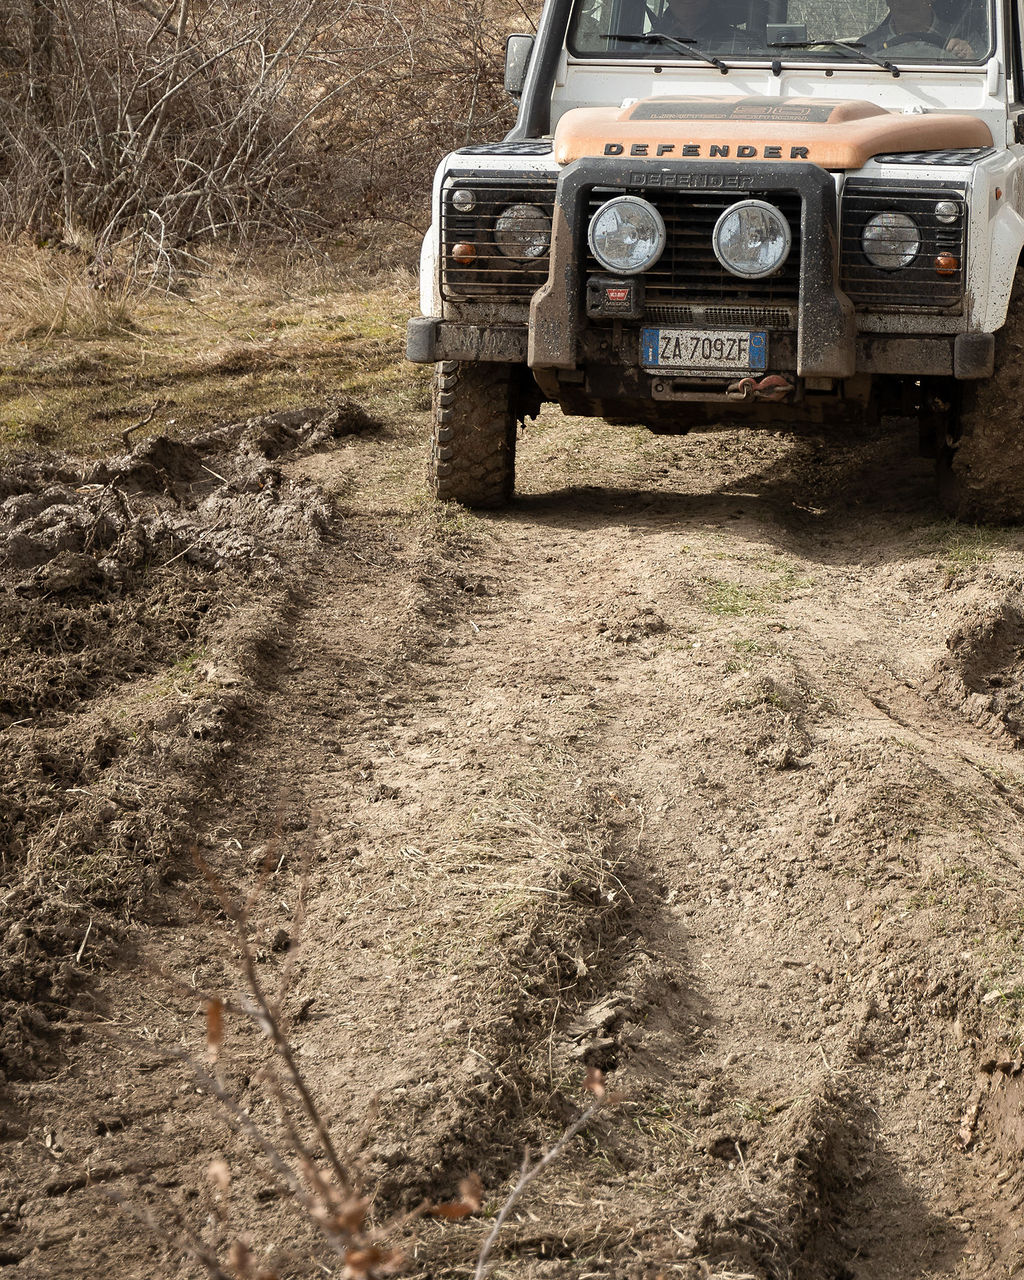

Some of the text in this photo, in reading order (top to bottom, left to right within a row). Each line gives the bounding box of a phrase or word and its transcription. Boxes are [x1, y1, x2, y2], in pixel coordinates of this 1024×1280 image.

[603, 143, 811, 159] DEFENDER
[630, 172, 754, 189] DEFENDER
[660, 336, 748, 361] ZA 709ZF
